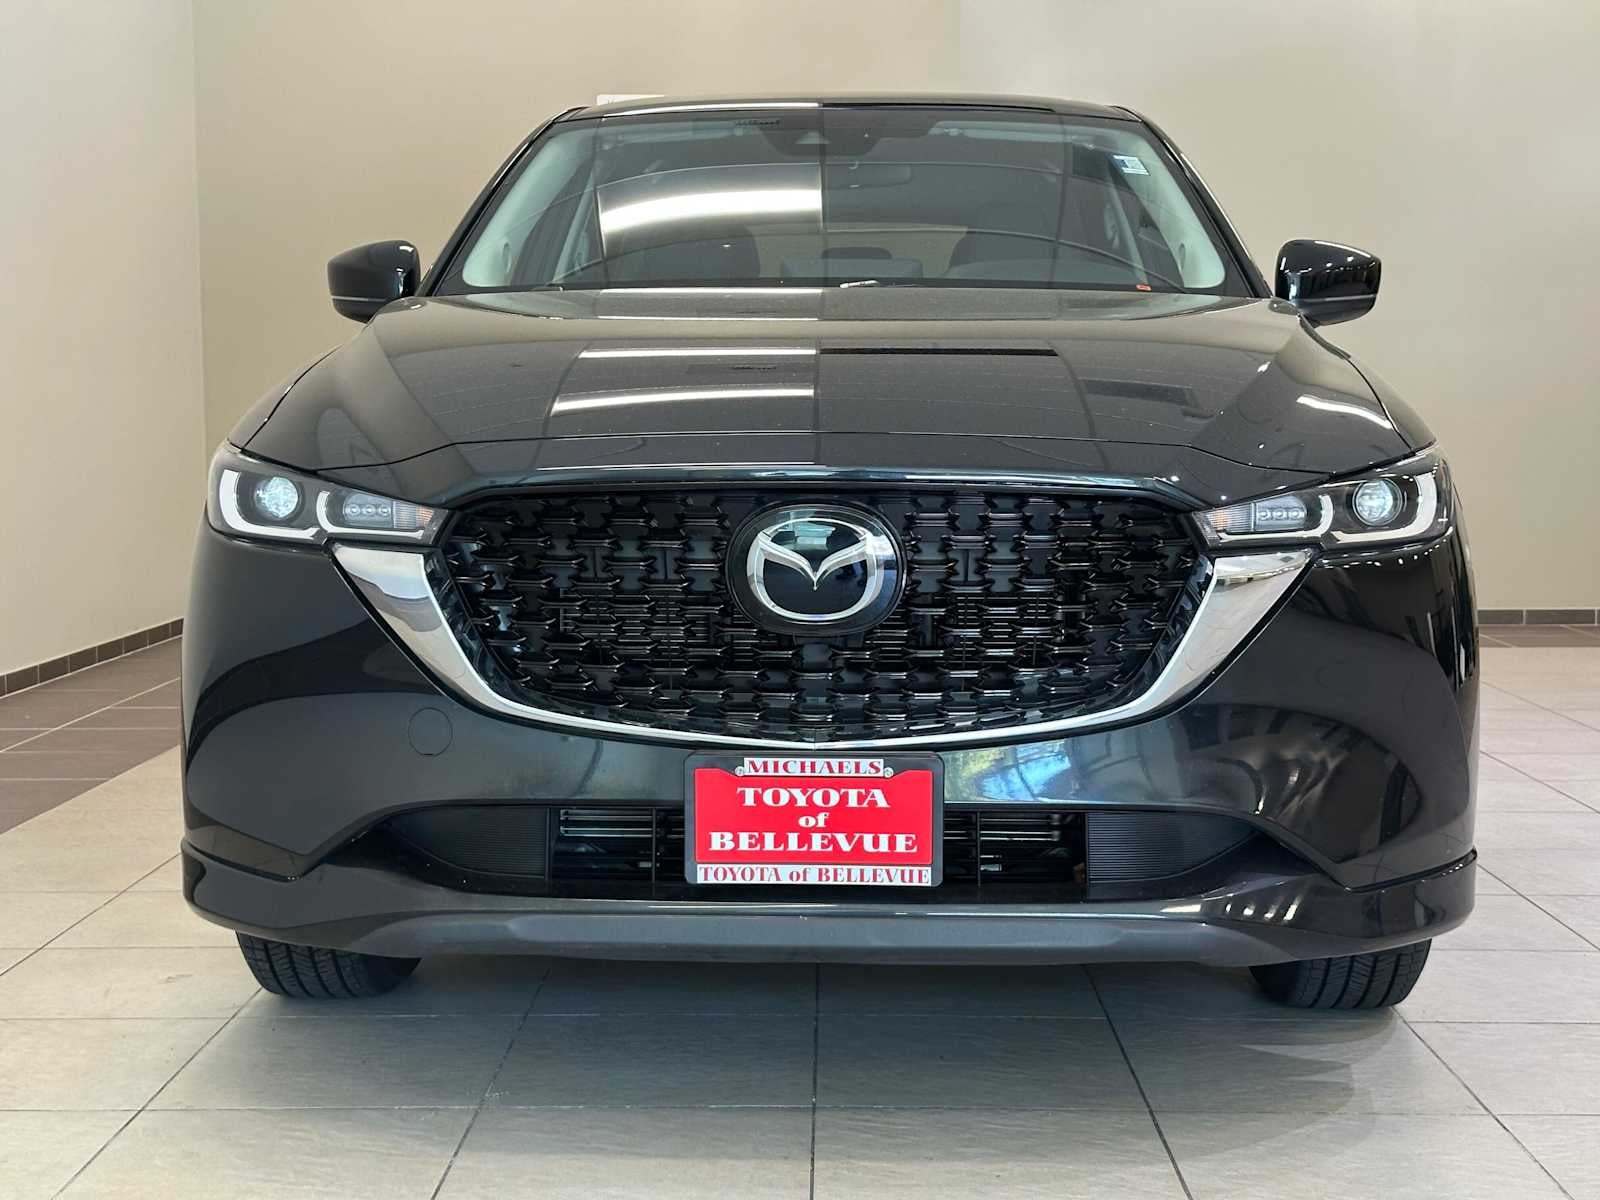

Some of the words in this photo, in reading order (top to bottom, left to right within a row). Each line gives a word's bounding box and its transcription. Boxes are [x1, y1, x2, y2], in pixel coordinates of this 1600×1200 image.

[747, 760, 882, 775] MICHAELS
[737, 787, 890, 808] TOYOTA
[798, 812, 830, 828] of
[708, 831, 918, 853] BELLEVUE
[699, 867, 783, 881] TOYOTA
[788, 867, 810, 883] of
[817, 868, 930, 884] BELLEVUE
